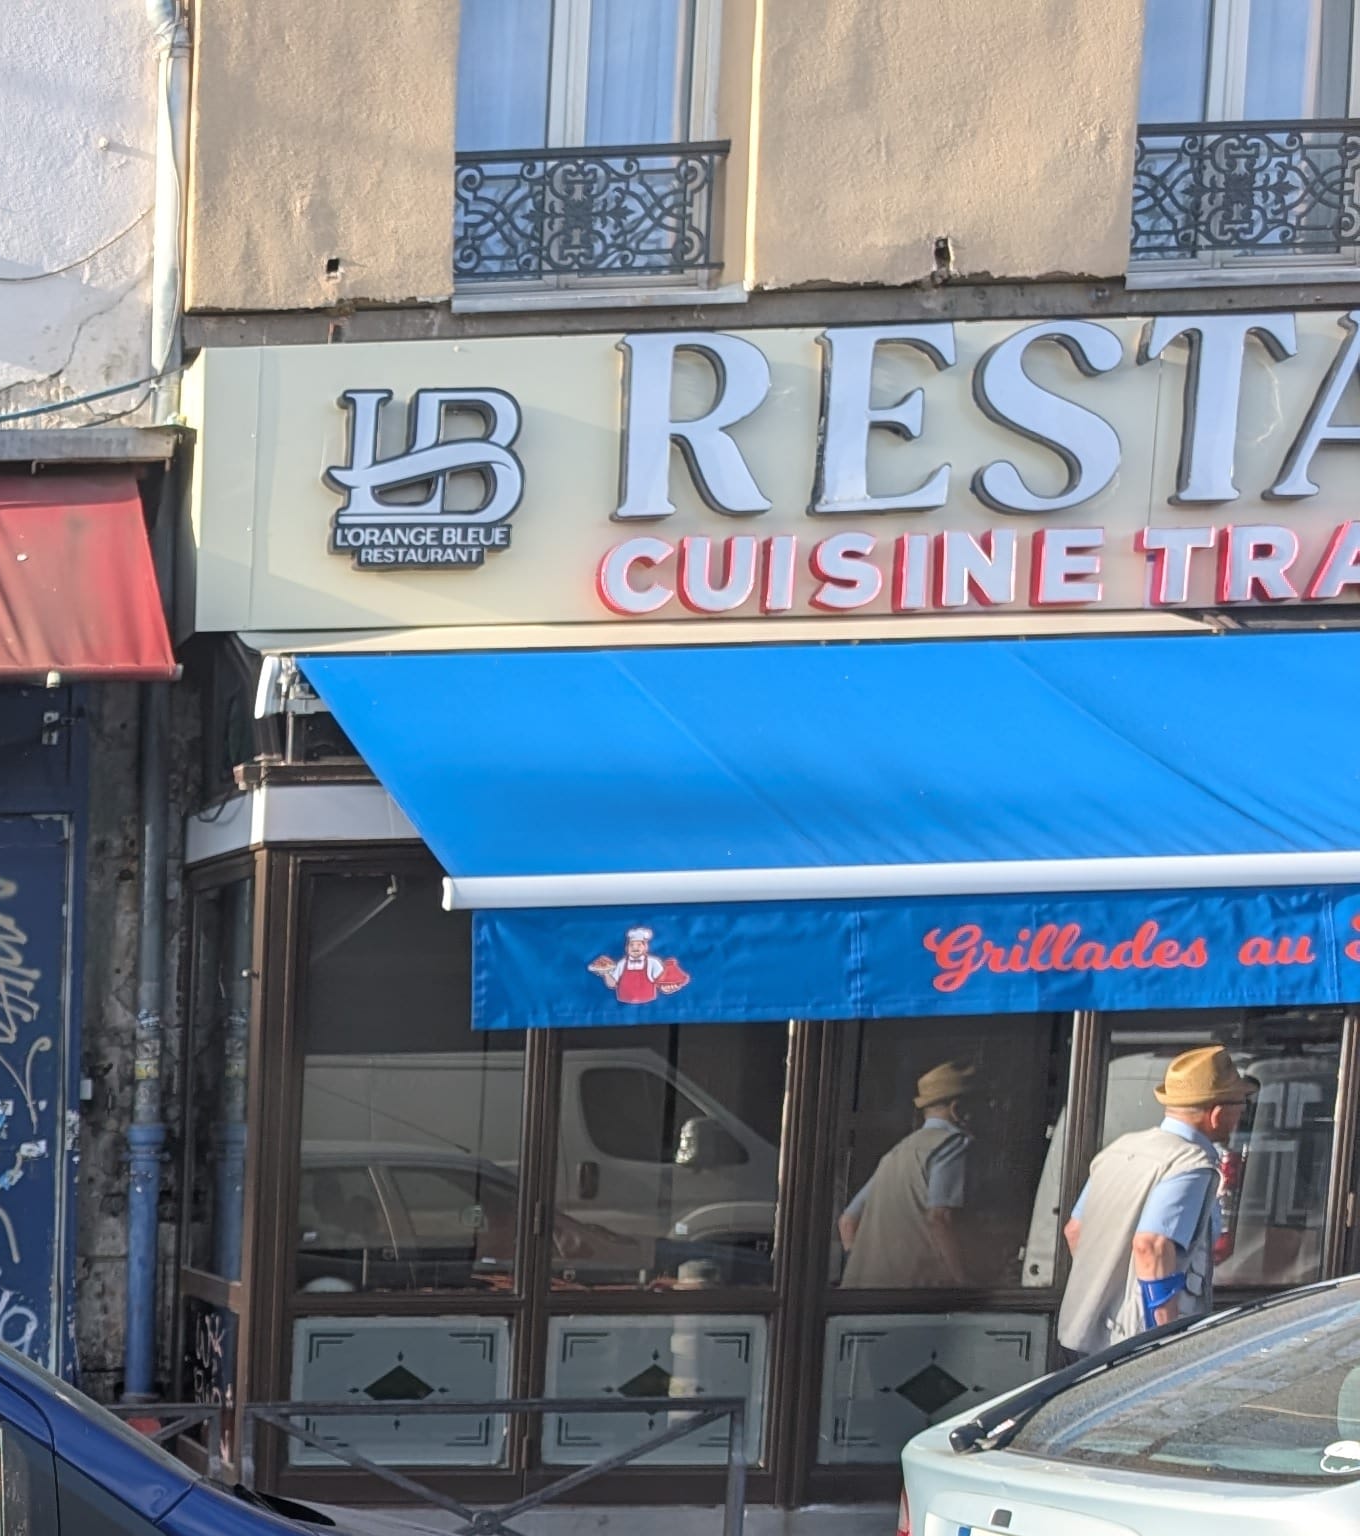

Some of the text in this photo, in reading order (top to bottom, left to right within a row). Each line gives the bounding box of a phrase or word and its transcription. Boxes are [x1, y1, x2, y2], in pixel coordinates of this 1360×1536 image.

[336, 526, 509, 547] L'ORANGE BLEUE
[360, 547, 482, 564] RESTAURANT
[595, 527, 1105, 615] CUISINE
[922, 918, 1208, 994] Grillades
[1237, 934, 1316, 967] au
